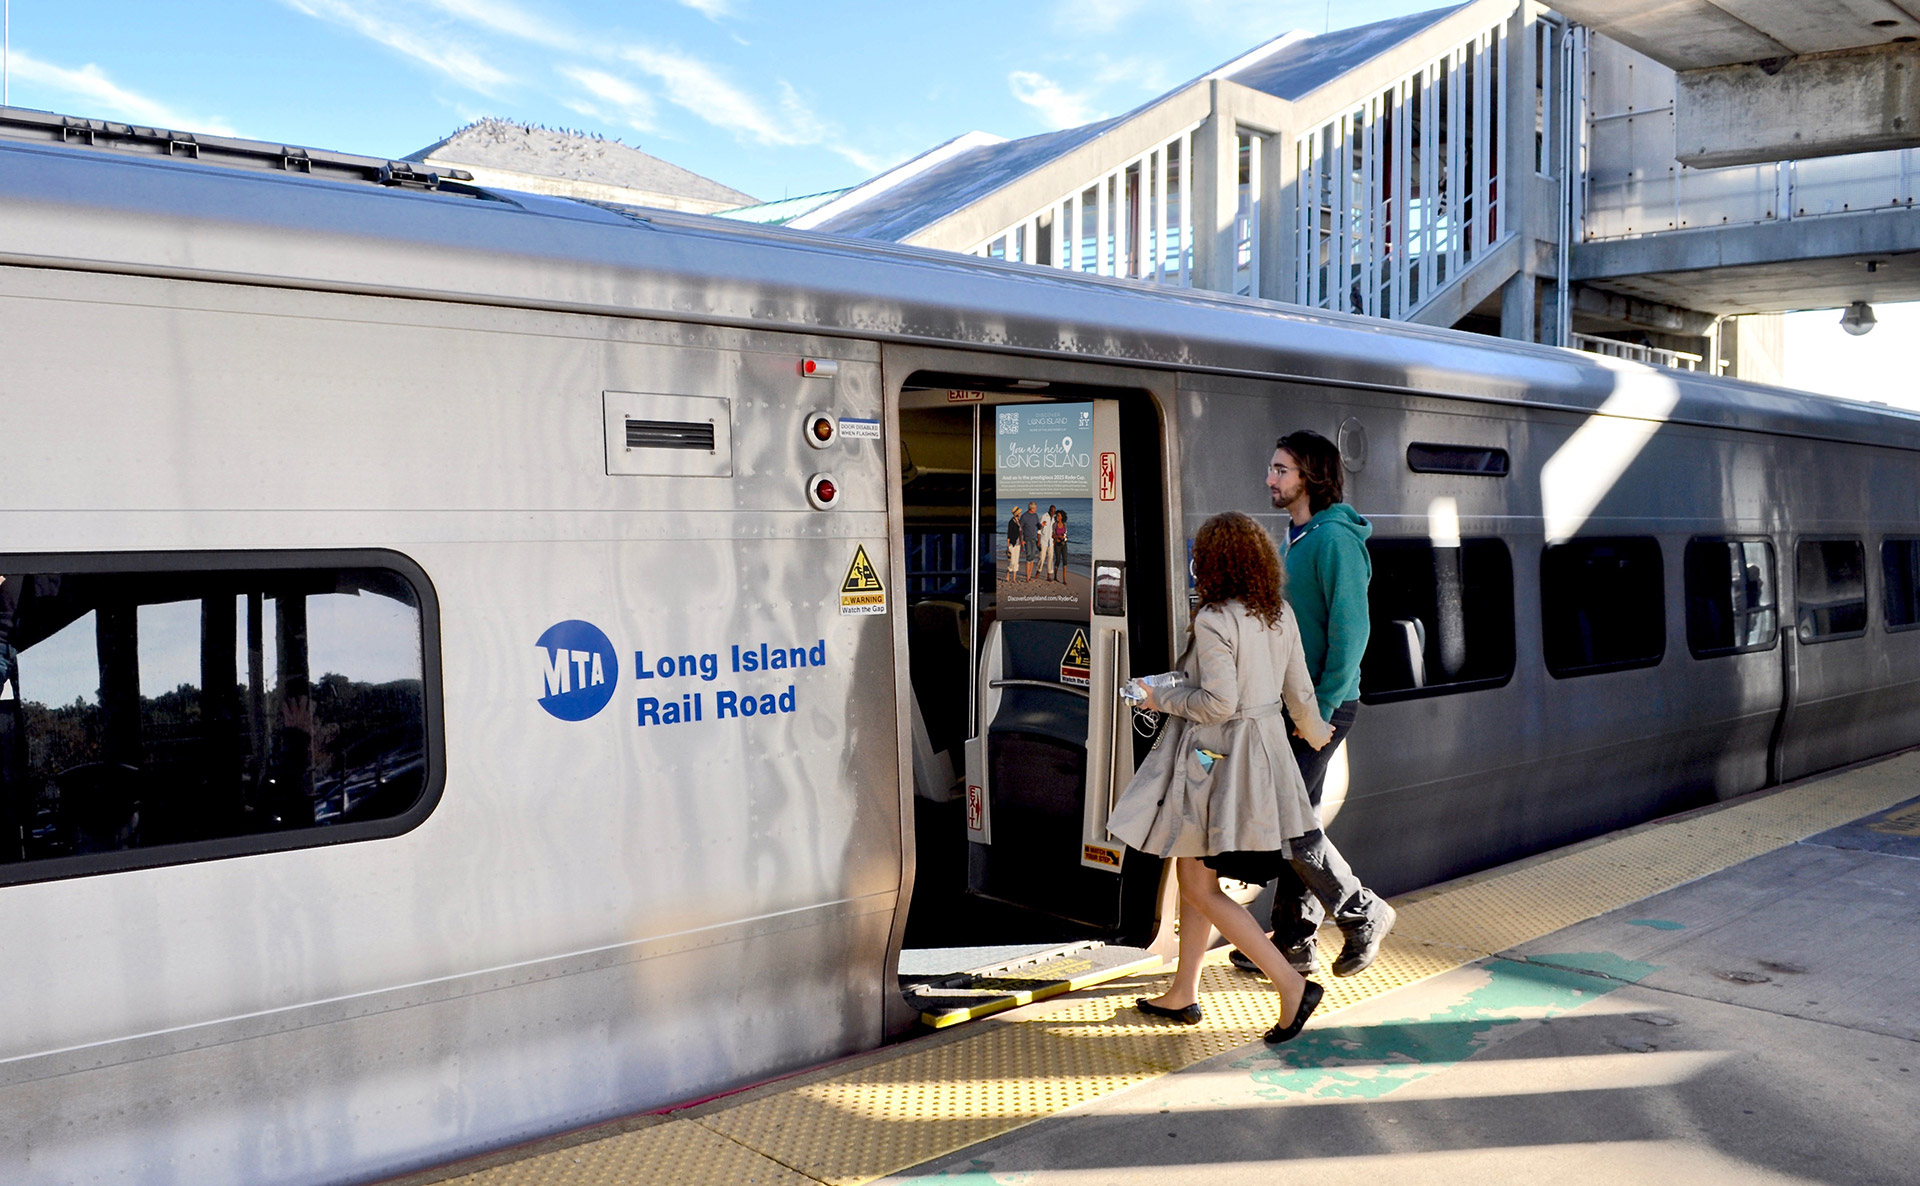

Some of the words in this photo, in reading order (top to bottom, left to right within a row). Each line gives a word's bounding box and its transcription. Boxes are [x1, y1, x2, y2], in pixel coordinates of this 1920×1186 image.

[999, 454, 1040, 468] LONG
[1044, 453, 1090, 468] ISLAND
[1009, 442, 1026, 455] You
[1027, 444, 1043, 454] are
[1044, 440, 1064, 454] here
[850, 596, 882, 604] WARNING
[536, 646, 604, 698] MTA
[635, 651, 718, 681] Long
[731, 639, 826, 673] Island
[637, 692, 702, 727] Rail
[716, 685, 796, 719] Road
